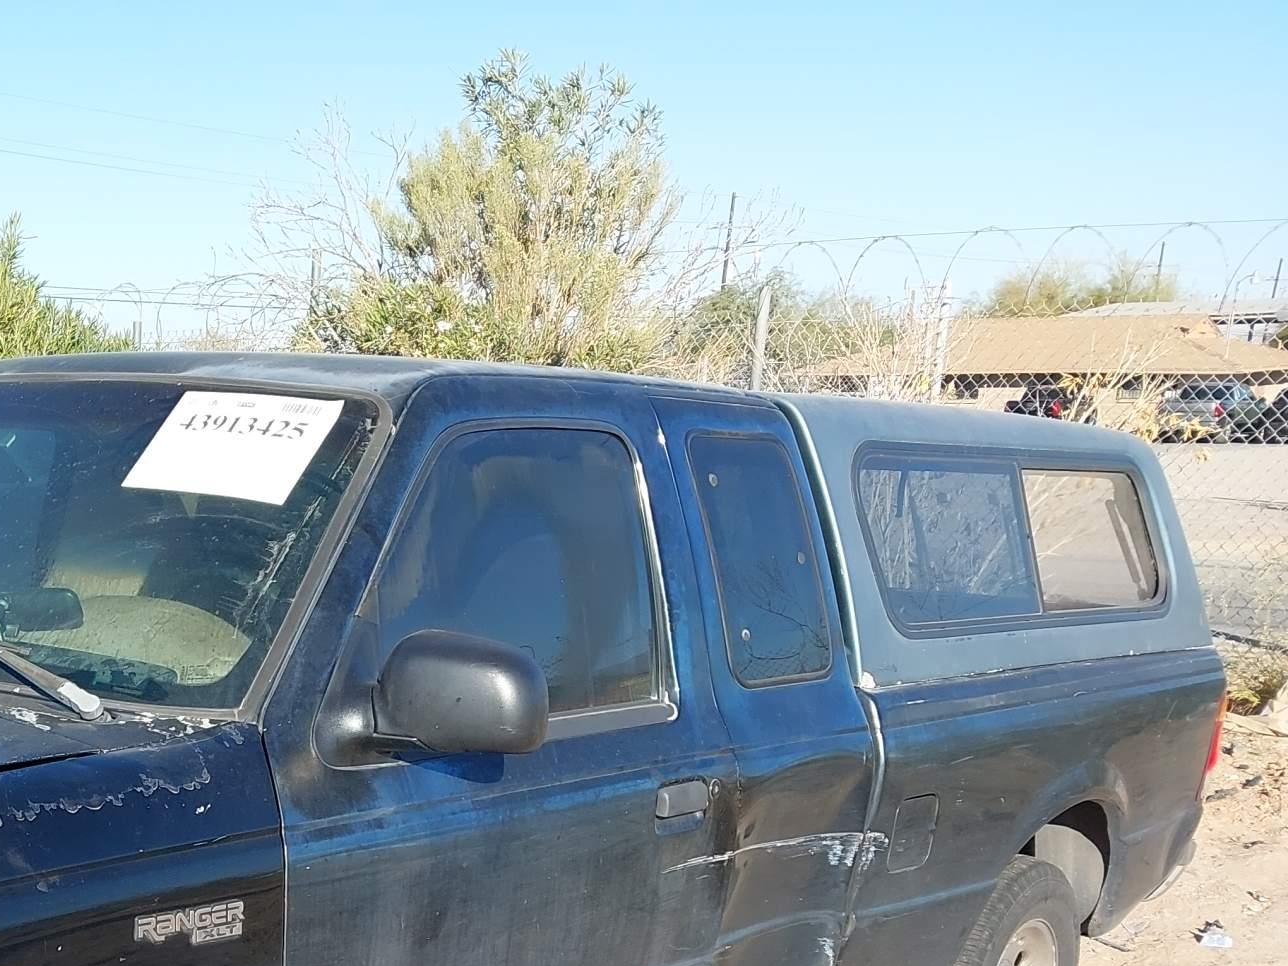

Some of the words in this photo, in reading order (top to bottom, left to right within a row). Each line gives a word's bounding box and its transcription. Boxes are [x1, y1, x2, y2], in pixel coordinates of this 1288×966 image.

[180, 413, 309, 440] 43913425
[135, 899, 245, 943] RANGER
[198, 923, 241, 942] XLT
